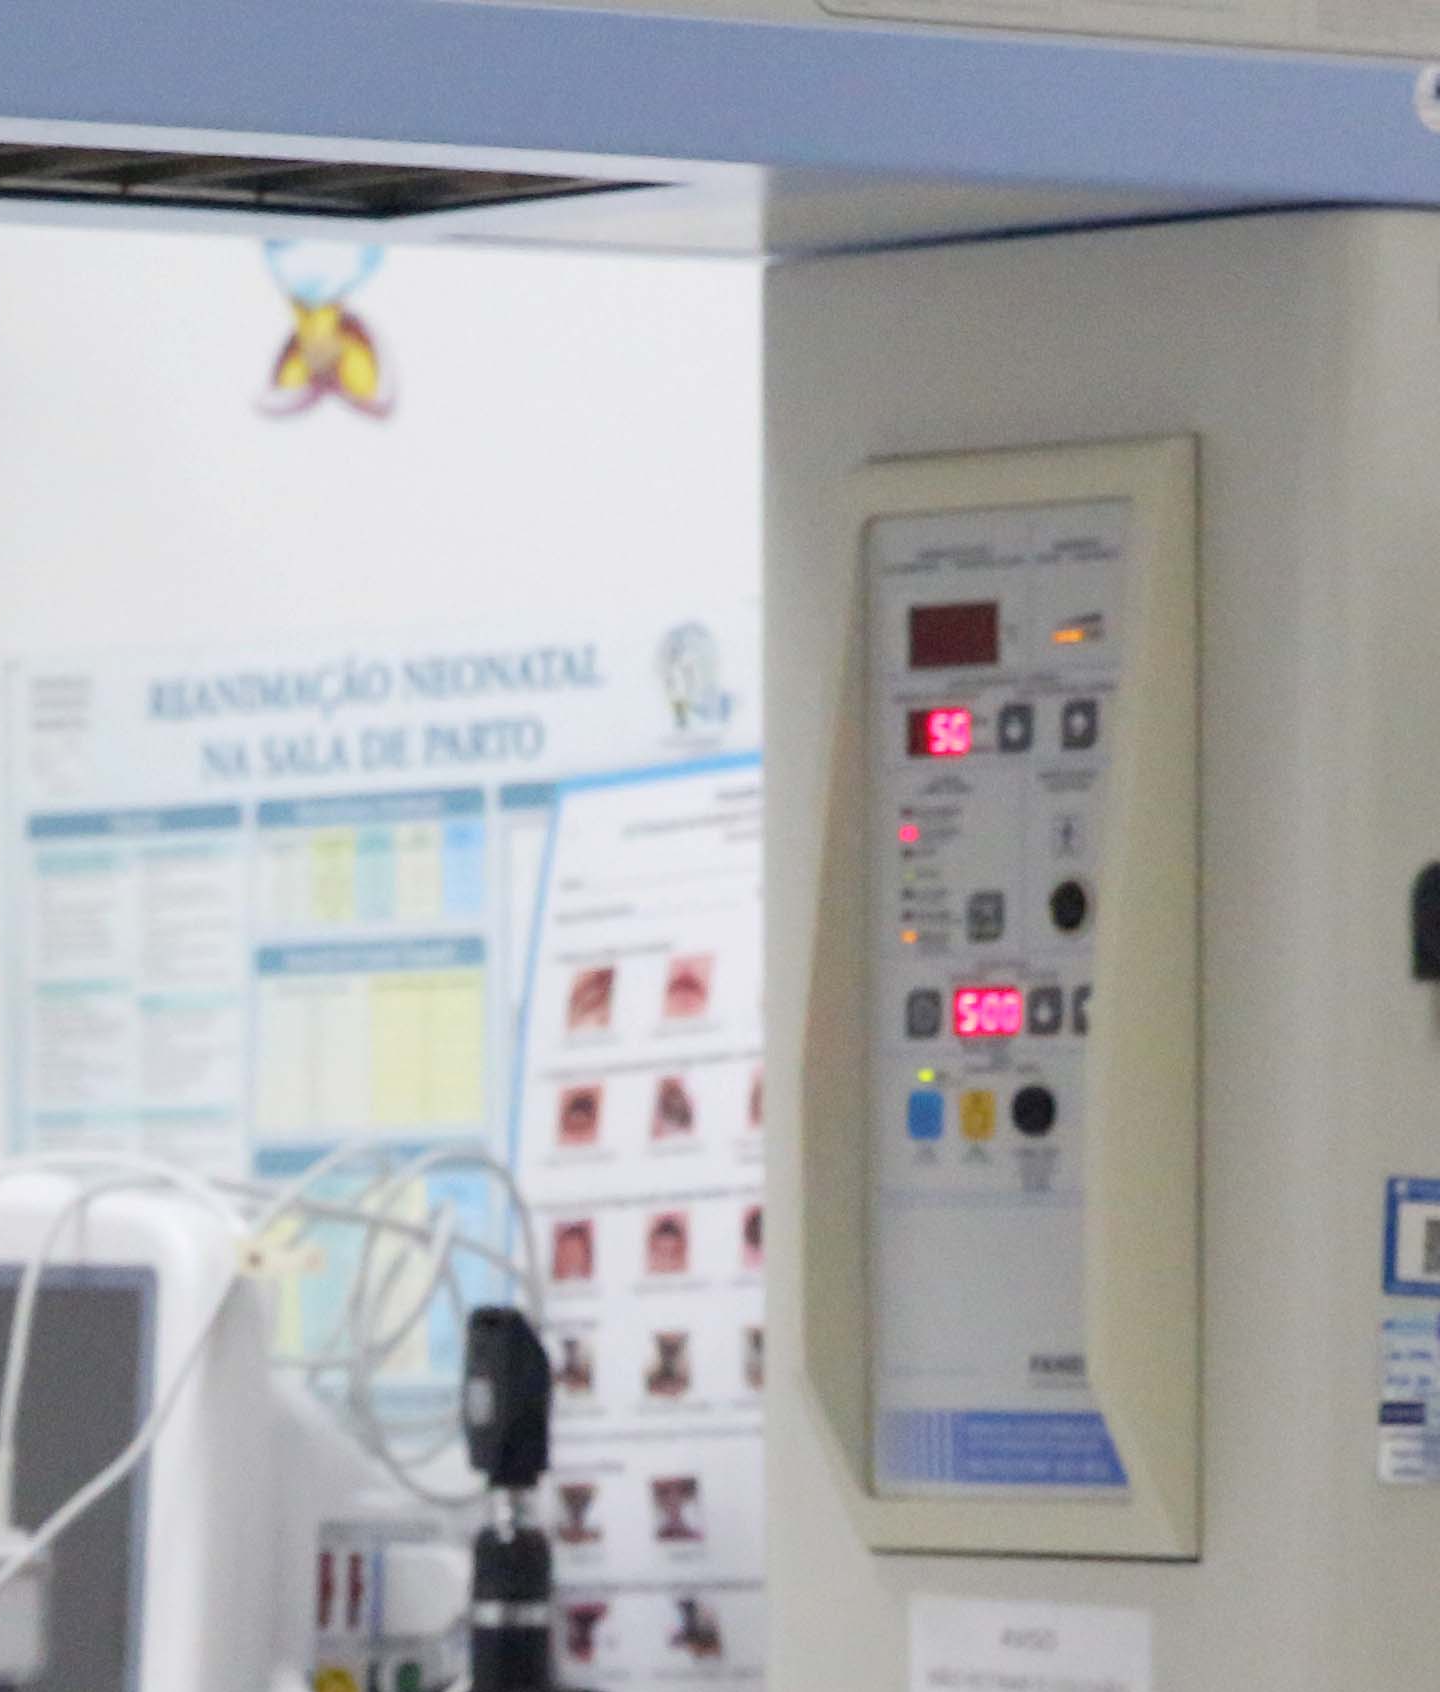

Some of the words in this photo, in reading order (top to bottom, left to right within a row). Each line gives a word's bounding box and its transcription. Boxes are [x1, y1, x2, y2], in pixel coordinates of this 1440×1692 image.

[147, 655, 394, 721] REANIMAÇÃO
[400, 645, 606, 696] NEONATAL
[201, 737, 249, 781] NA
[262, 733, 348, 776] SALA
[360, 728, 406, 768] DE
[423, 716, 545, 762] PARTO
